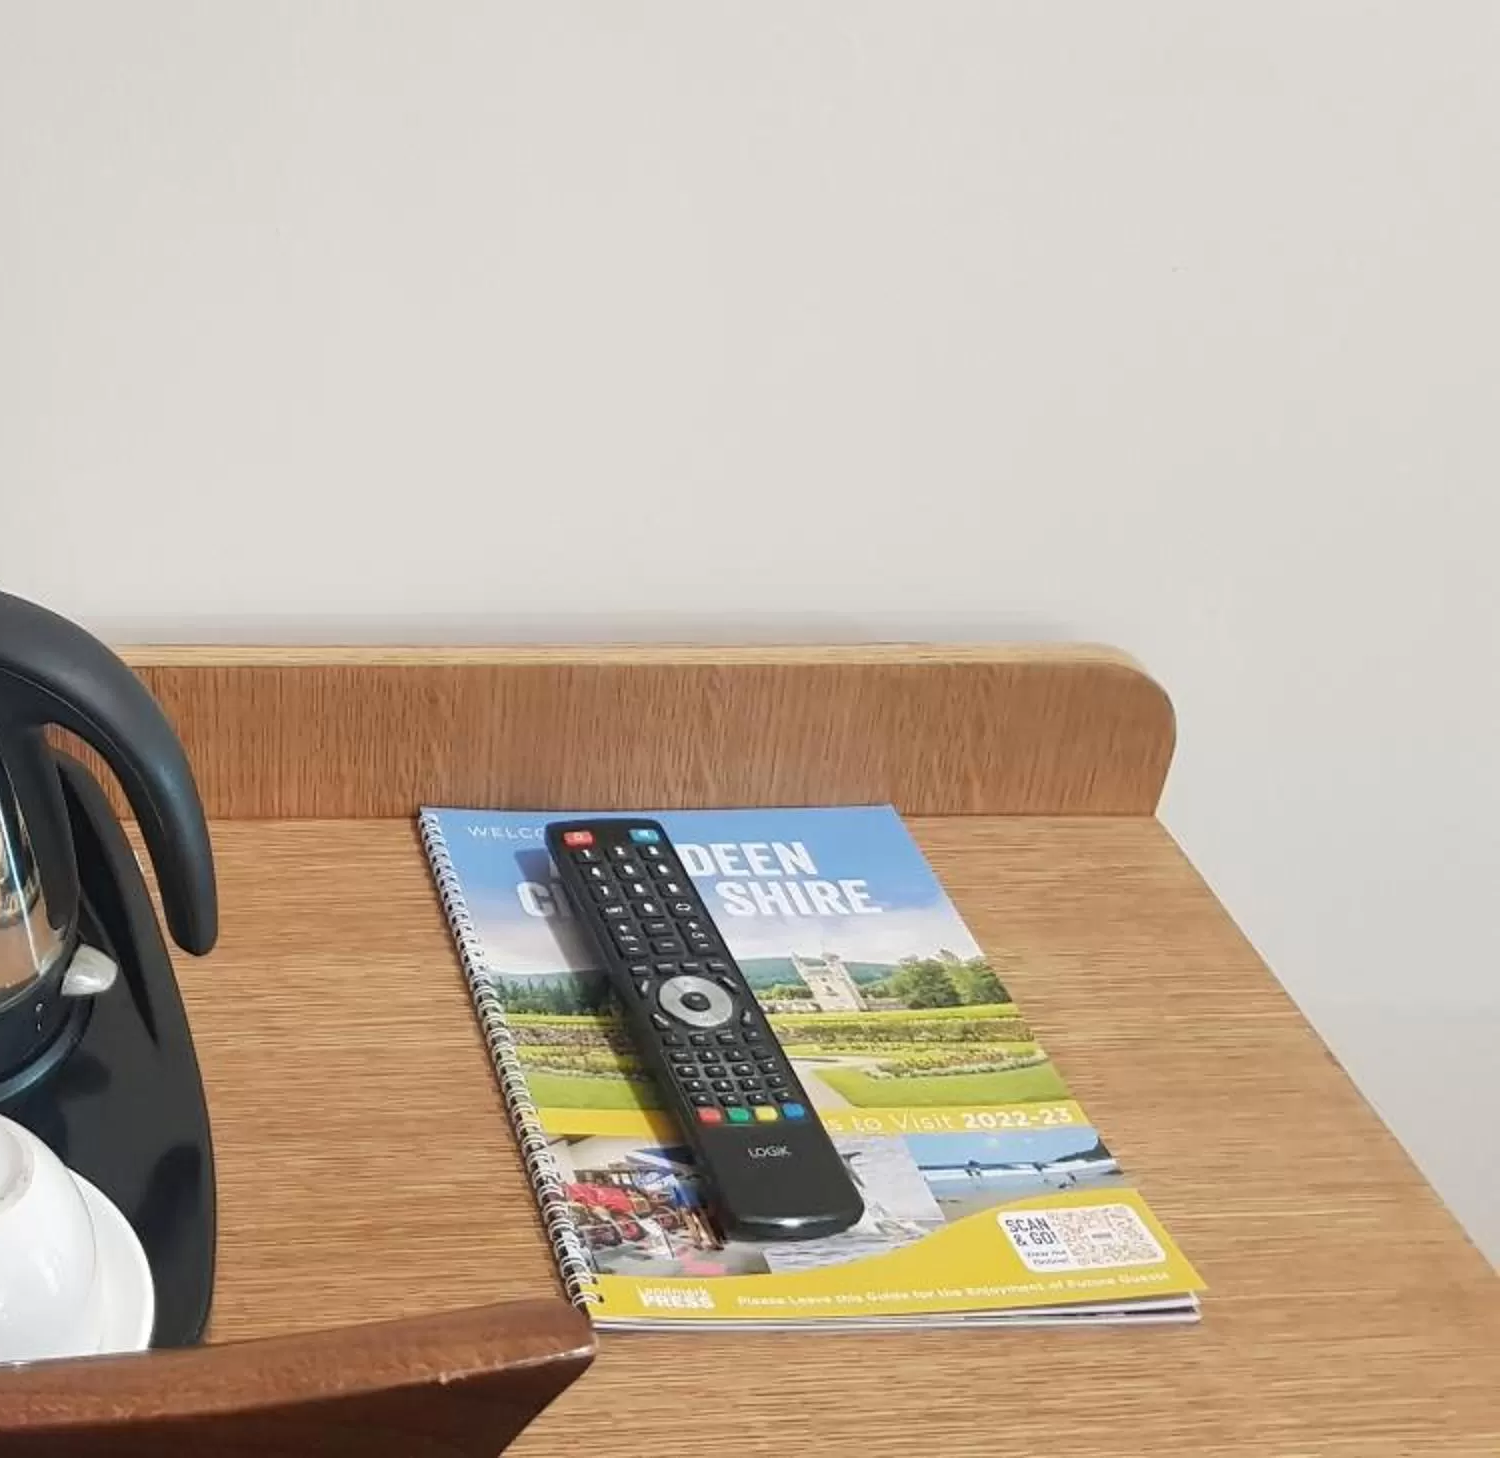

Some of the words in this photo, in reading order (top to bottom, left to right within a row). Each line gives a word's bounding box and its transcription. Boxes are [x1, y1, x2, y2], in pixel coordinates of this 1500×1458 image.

[467, 825, 546, 840] WELCO
[715, 879, 884, 916] SHIRE
[851, 1117, 883, 1132] to
[890, 1113, 954, 1132] Visit
[962, 1107, 1073, 1130] 2022-23
[1005, 1217, 1051, 1233] SCAN
[1013, 1233, 1028, 1247] &
[1030, 1232, 1061, 1246] GO!
[738, 1295, 785, 1306] Please
[788, 1295, 832, 1305] Leave
[865, 1290, 909, 1301] Guide
[967, 1283, 1045, 1297] Enjoyment
